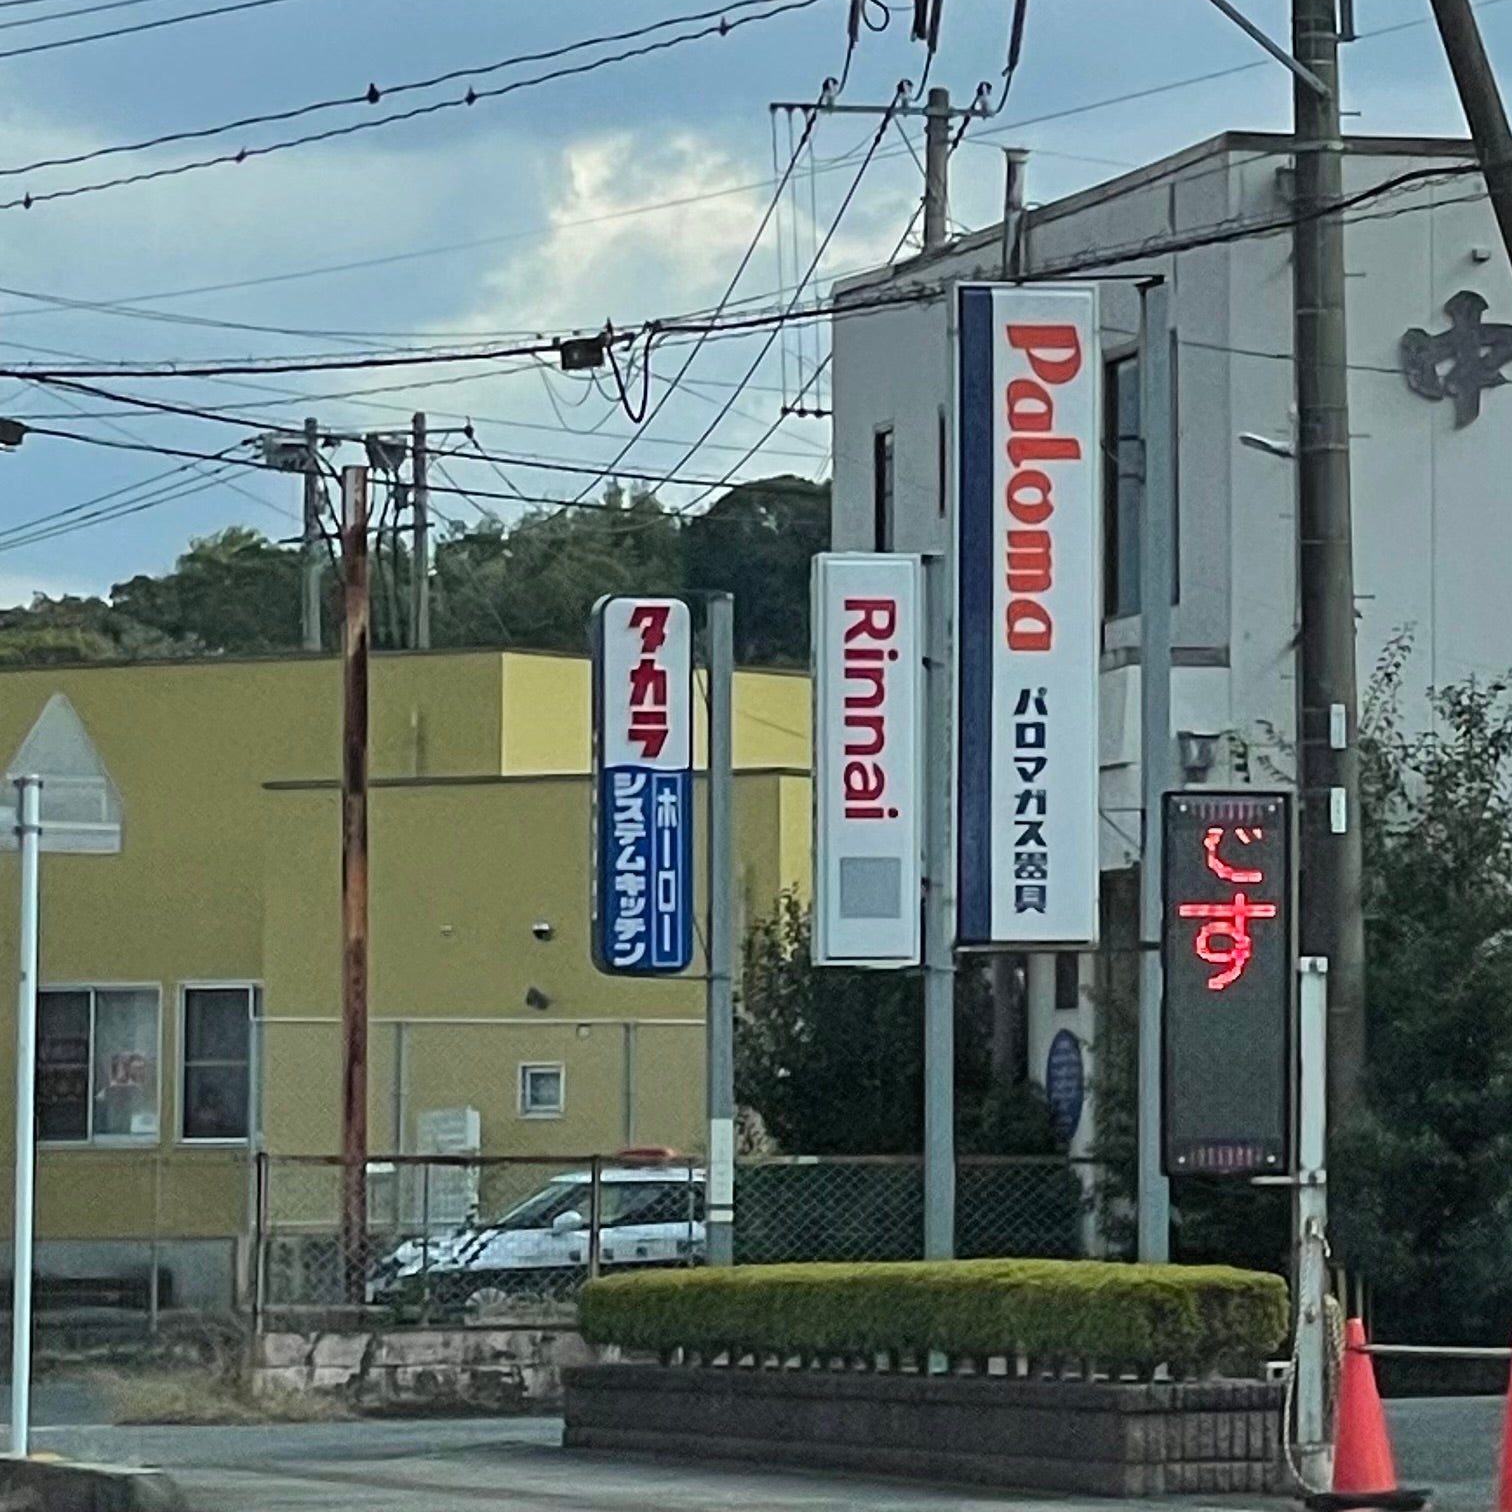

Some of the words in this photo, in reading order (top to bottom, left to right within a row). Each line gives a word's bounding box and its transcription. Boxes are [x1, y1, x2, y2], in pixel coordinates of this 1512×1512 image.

[1006, 325, 1082, 651] Paloma
[628, 606, 671, 758] タカラ
[843, 599, 899, 819] Rinnai
[613, 772, 647, 967] システムキッチン
[657, 787, 677, 952] ホーロー
[1013, 686, 1049, 914] パロマガス器具
